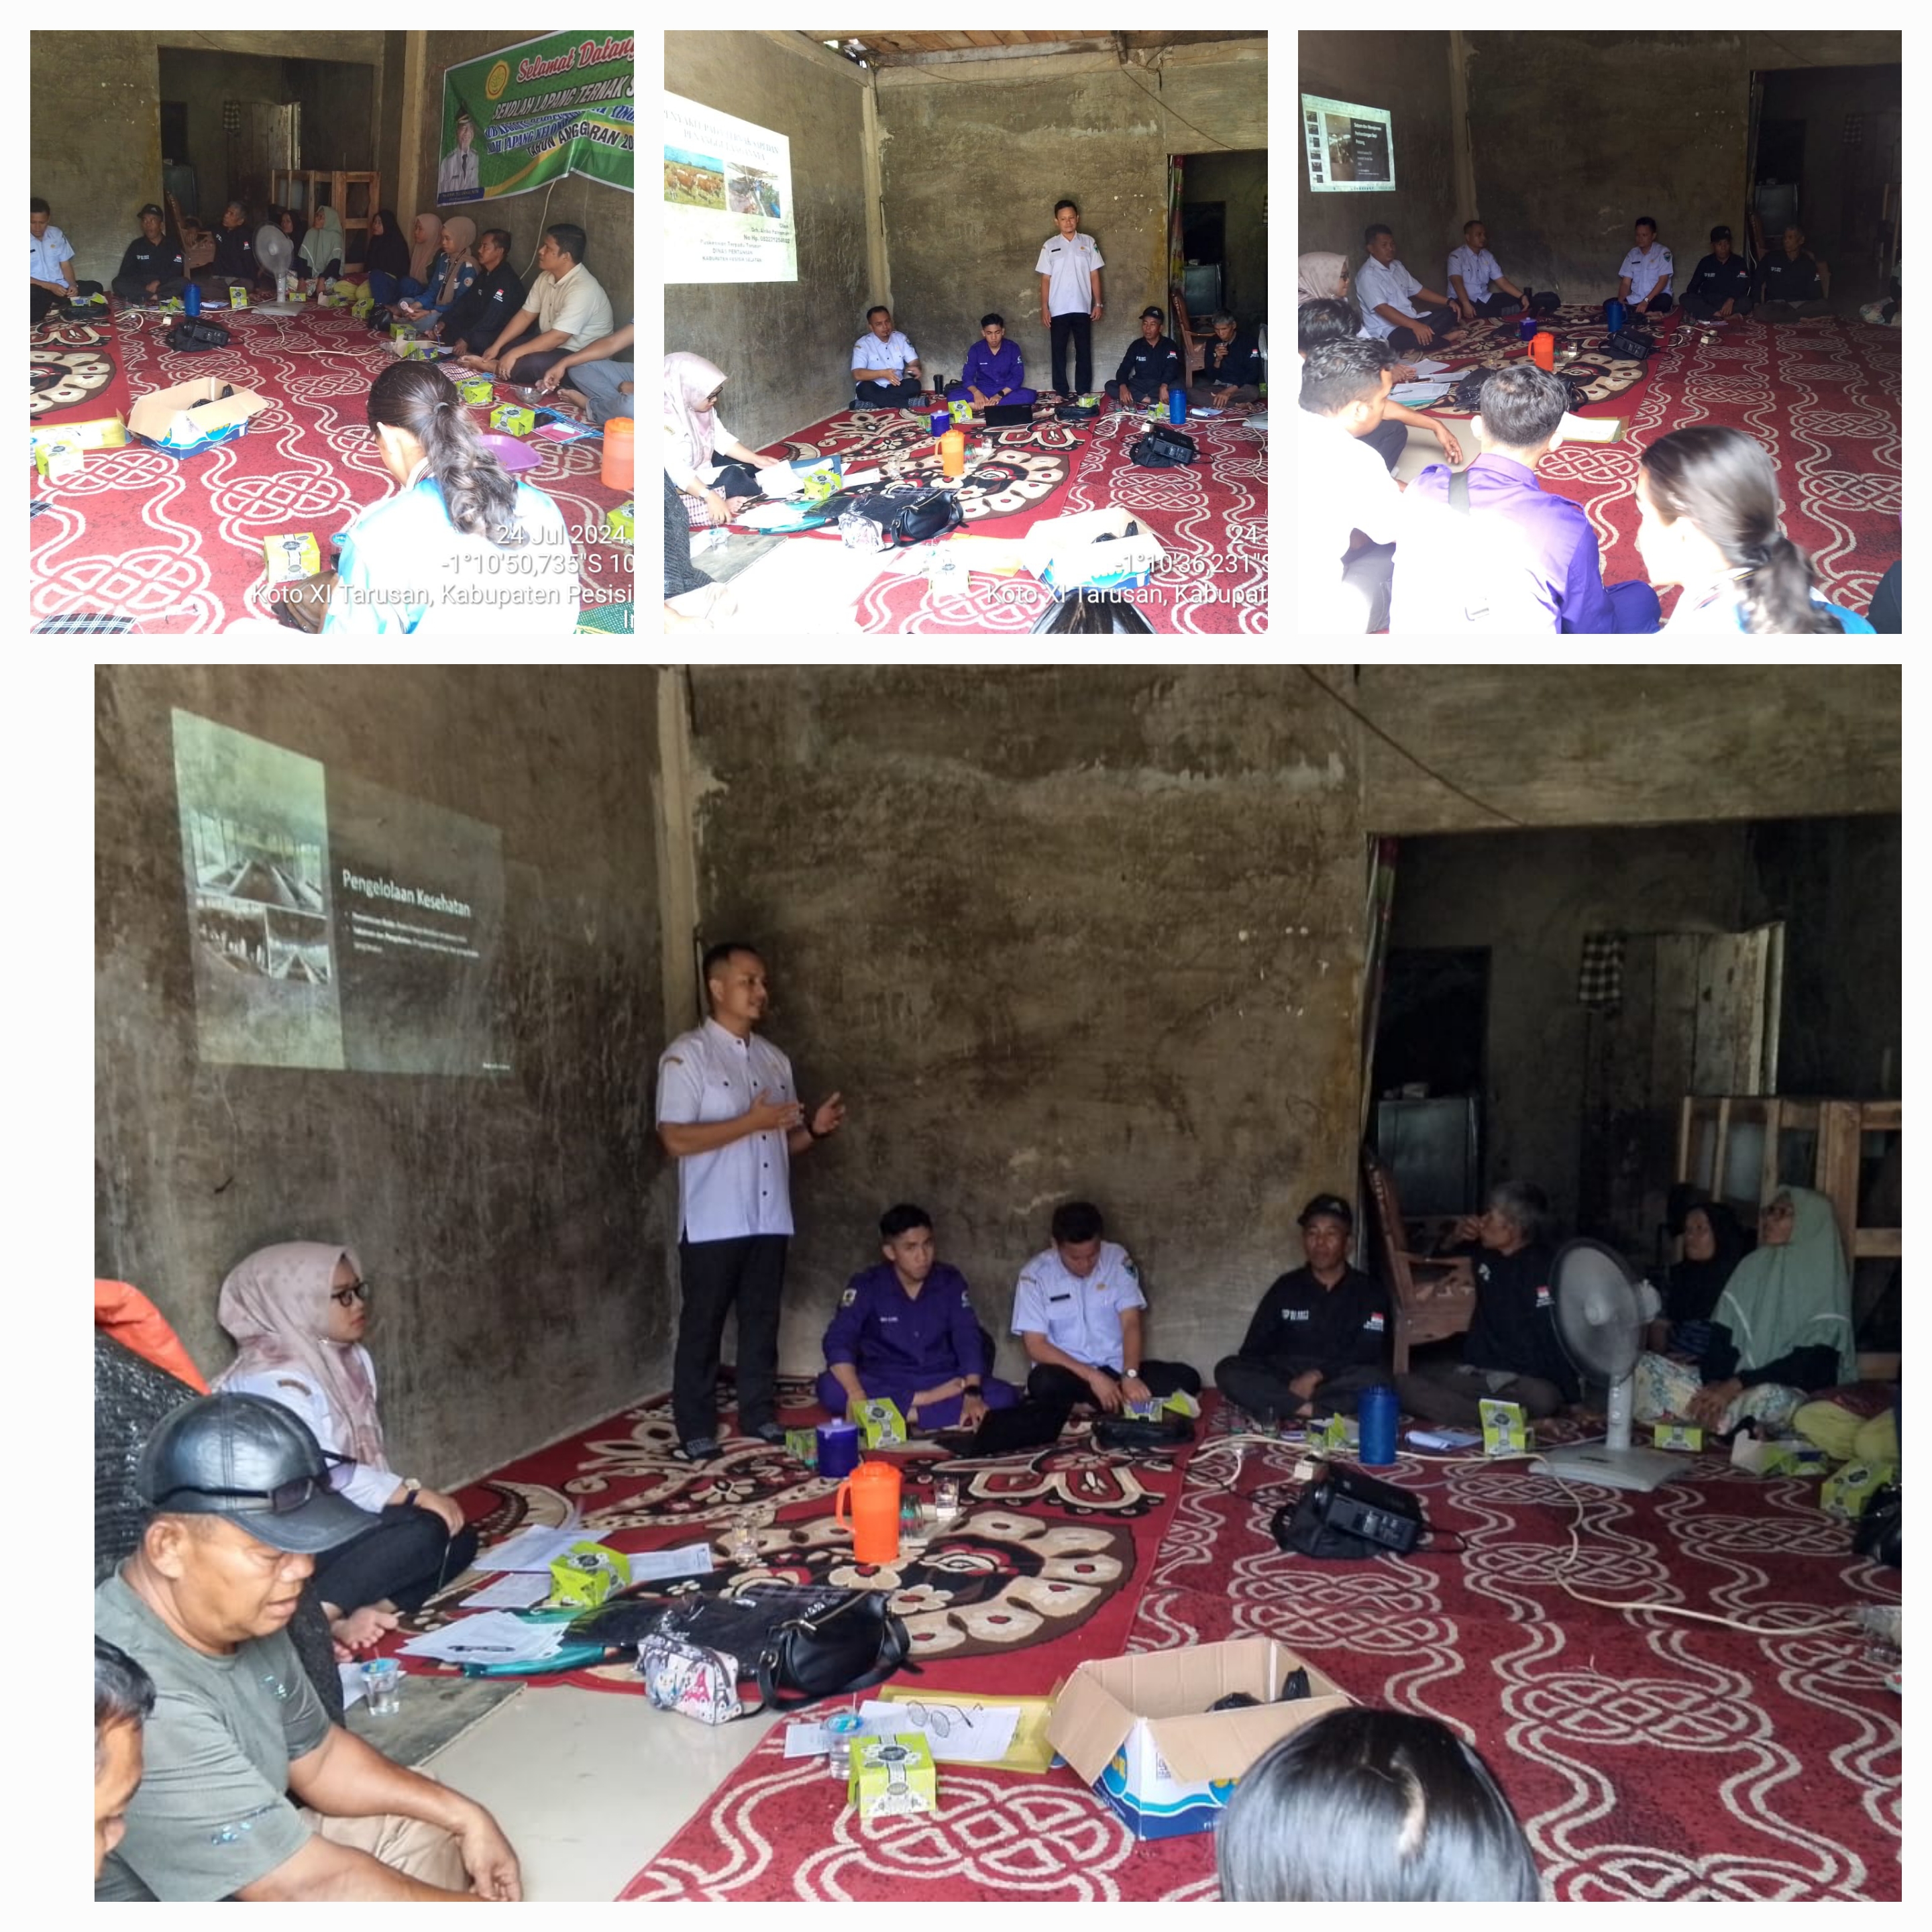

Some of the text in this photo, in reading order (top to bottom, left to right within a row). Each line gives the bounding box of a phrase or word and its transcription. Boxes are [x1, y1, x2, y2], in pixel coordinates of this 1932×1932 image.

[517, 47, 575, 83] Selamat
[492, 95, 534, 121] SEKOLAH
[532, 87, 576, 115] LAPANG
[575, 74, 630, 104] TERNAK
[527, 136, 556, 158] TAHUN
[342, 868, 471, 917] Pengelolaan Kesehatan
